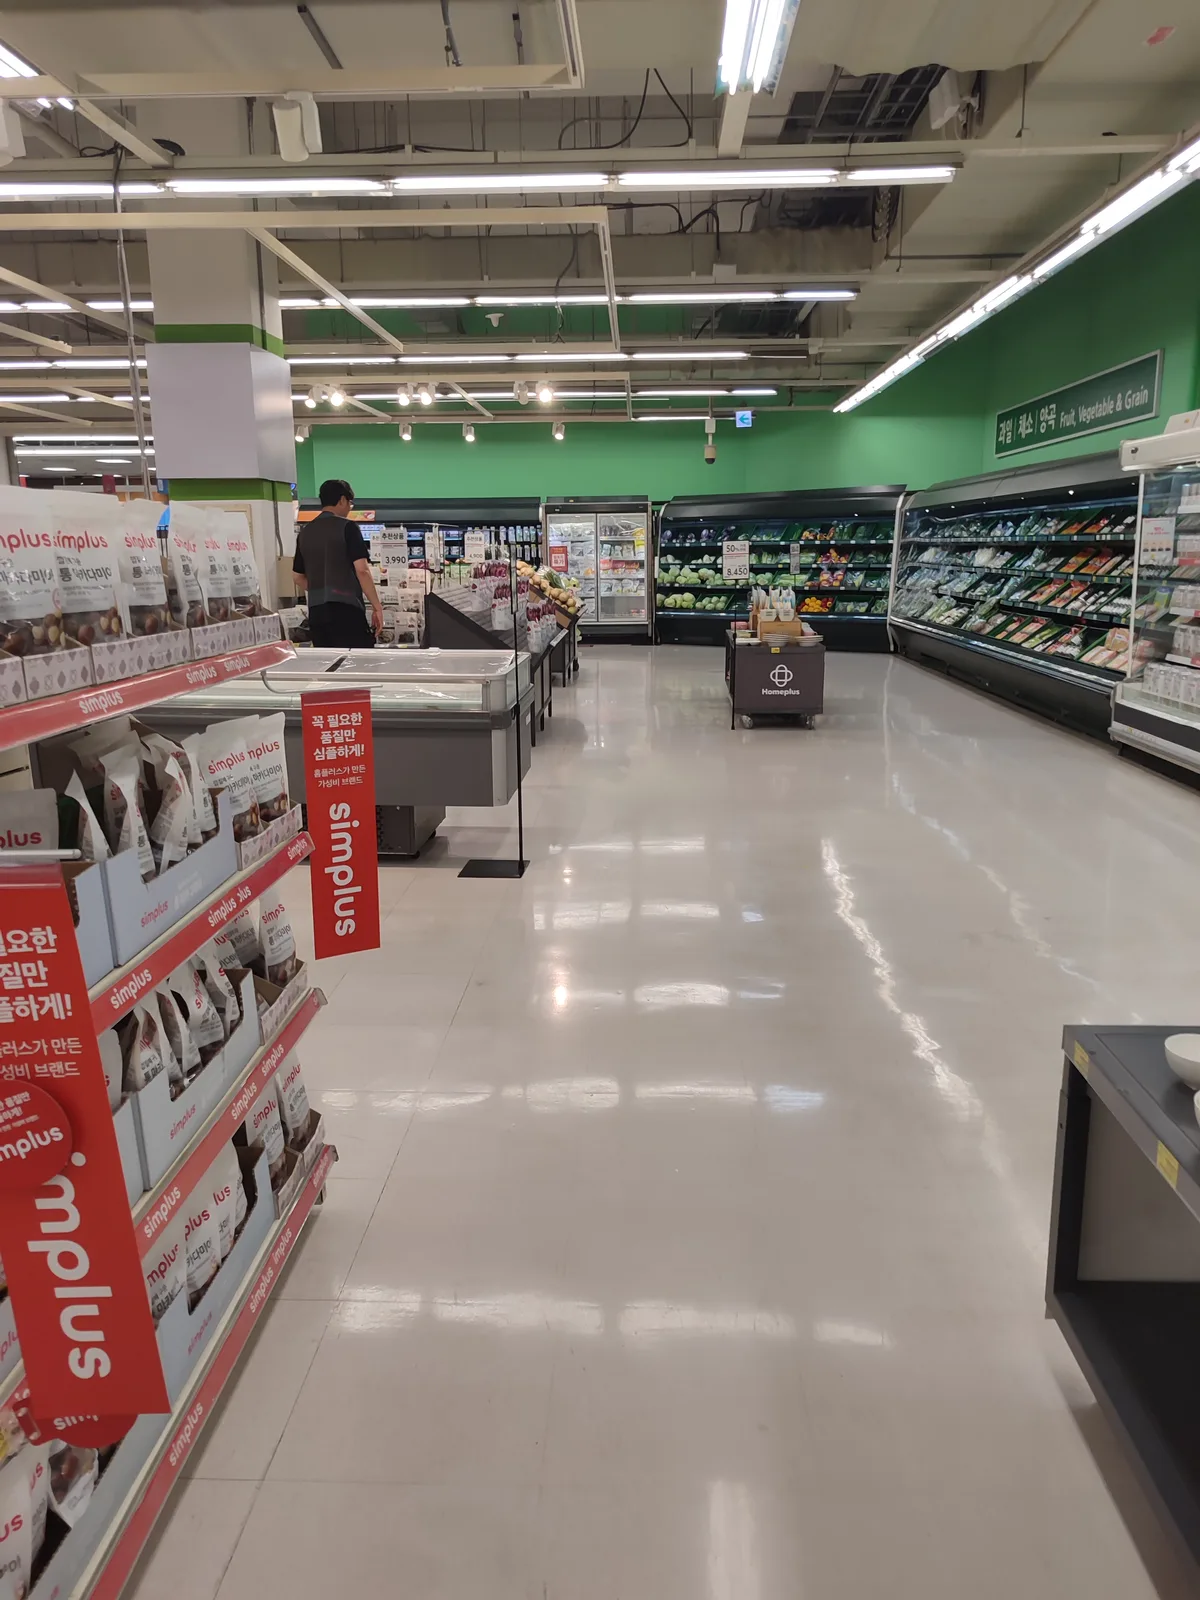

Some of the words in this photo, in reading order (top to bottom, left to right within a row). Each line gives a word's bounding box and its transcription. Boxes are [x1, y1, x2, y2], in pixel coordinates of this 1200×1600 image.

[998, 419, 1013, 445] 과일
[1018, 411, 1033, 439] 채소
[1040, 403, 1056, 434] 양곡
[1078, 396, 1114, 424] Vegetable
[1124, 386, 1149, 410] Grain
[382, 532, 404, 541] 추천상품
[186, 663, 217, 684] simplus
[223, 654, 251, 676] simplus
[78, 690, 124, 715] simplus
[762, 688, 800, 698] Homeplus
[312, 715, 324, 728] 꼭
[327, 712, 363, 726] 필요한
[320, 729, 356, 745] 품질만
[313, 743, 365, 761] 심플하게!
[341, 775, 363, 787] 브랜드
[351, 764, 367, 776] 만든
[287, 837, 308, 861] simplus
[324, 801, 362, 937] simplus
[141, 901, 169, 928] simplus
[208, 897, 238, 928] simplus
[110, 967, 153, 1011] simplus
[51, 1038, 83, 1055] 만든
[34, 1061, 81, 1079] 브랜드
[261, 1044, 285, 1077] simplus
[231, 1081, 258, 1121] simplus
[144, 1186, 182, 1240] simplus
[249, 1267, 275, 1314] simplus
[169, 1402, 204, 1467] simplus
